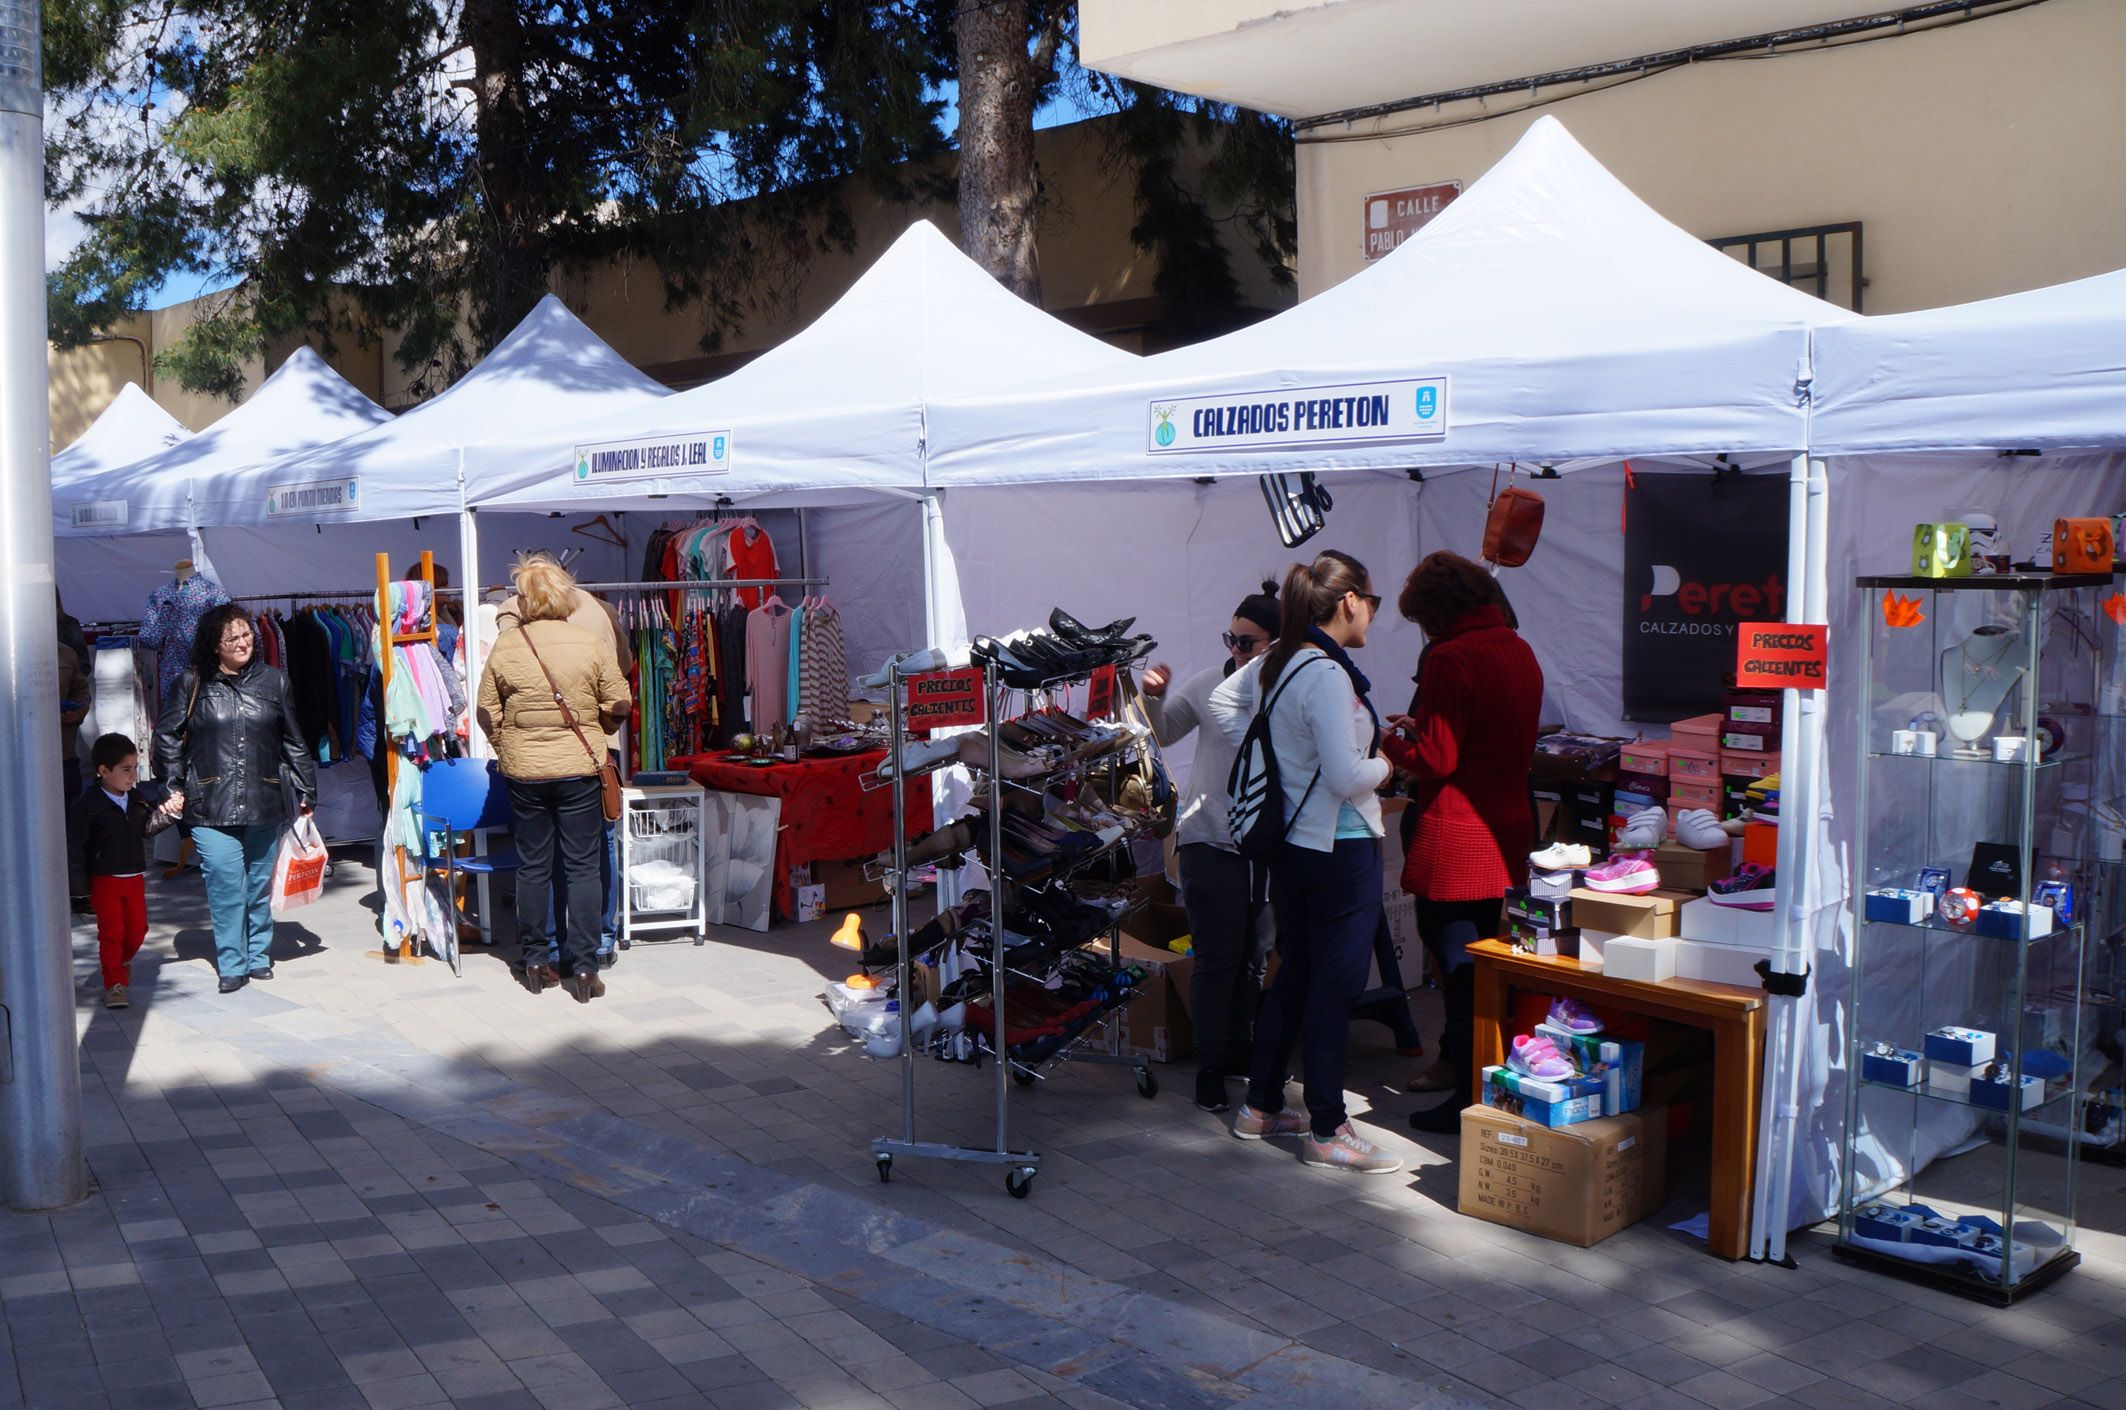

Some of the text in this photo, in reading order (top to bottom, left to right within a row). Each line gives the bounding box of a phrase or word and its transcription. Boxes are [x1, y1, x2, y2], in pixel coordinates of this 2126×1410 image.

[1397, 196, 1439, 217] CALLE
[1193, 394, 1389, 438] CALZADOS PERETON
[592, 447, 640, 473] ILUMINACION
[648, 444, 680, 468] REGALOS
[689, 442, 707, 464] LEAL
[1640, 565, 1787, 616] Peret
[1640, 621, 1735, 637] CALZADOS Y
[1752, 632, 1816, 651] PRECIOS
[1744, 659, 1822, 677] CALIENTES
[917, 677, 973, 696] PRECIOS
[909, 697, 977, 717] CALIENTES
